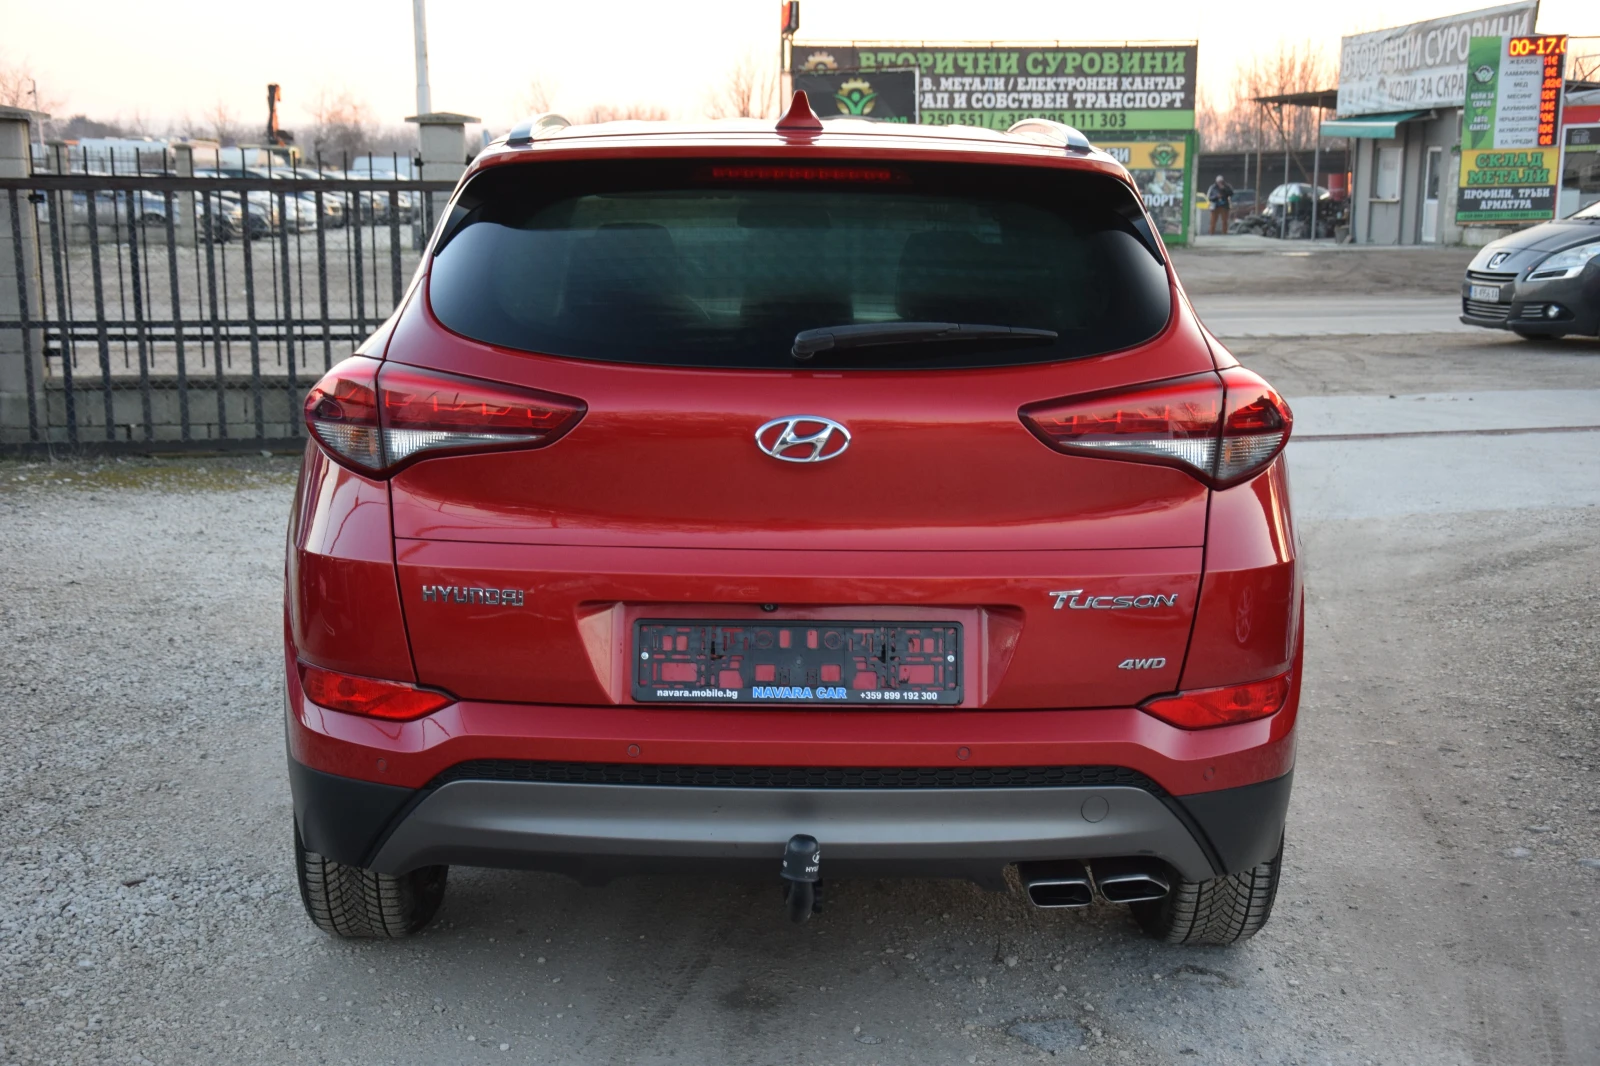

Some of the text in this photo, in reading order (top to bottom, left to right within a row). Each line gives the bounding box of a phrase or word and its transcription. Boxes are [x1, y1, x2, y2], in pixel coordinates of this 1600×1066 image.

[859, 52, 1186, 74] ВТОРИЧНИ СУРОВИНИ
[920, 77, 937, 91] В.
[940, 77, 1005, 91] МЕТАЛИ
[1017, 77, 1118, 91] ЕЛЕКТРОНЕН
[1121, 77, 1186, 91] КАНТАР
[1421, 78, 1433, 97] ЗА
[953, 93, 967, 108] И
[971, 92, 1068, 109] СОБСТВЕН
[1073, 92, 1184, 109] ТРАНСПОРТ
[1071, 113, 1095, 127] 111
[1100, 113, 1127, 127] 303
[1106, 148, 1129, 163] ЗИ
[1475, 152, 1544, 168] СКЛАД
[1467, 168, 1550, 185] МЕТАЛИ
[1464, 187, 1550, 199] ПРОФИЛИ, ТРЪБИ
[1142, 194, 1174, 207] ПОРТ
[1479, 199, 1532, 210] АРМАТУРА
[422, 585, 524, 606] HYUNDAI
[1118, 657, 1166, 670] 4WD
[657, 688, 738, 700] navara.mobile.bg
[752, 686, 847, 699] NAVARA CAR
[860, 691, 937, 700] +359 899 192 300
